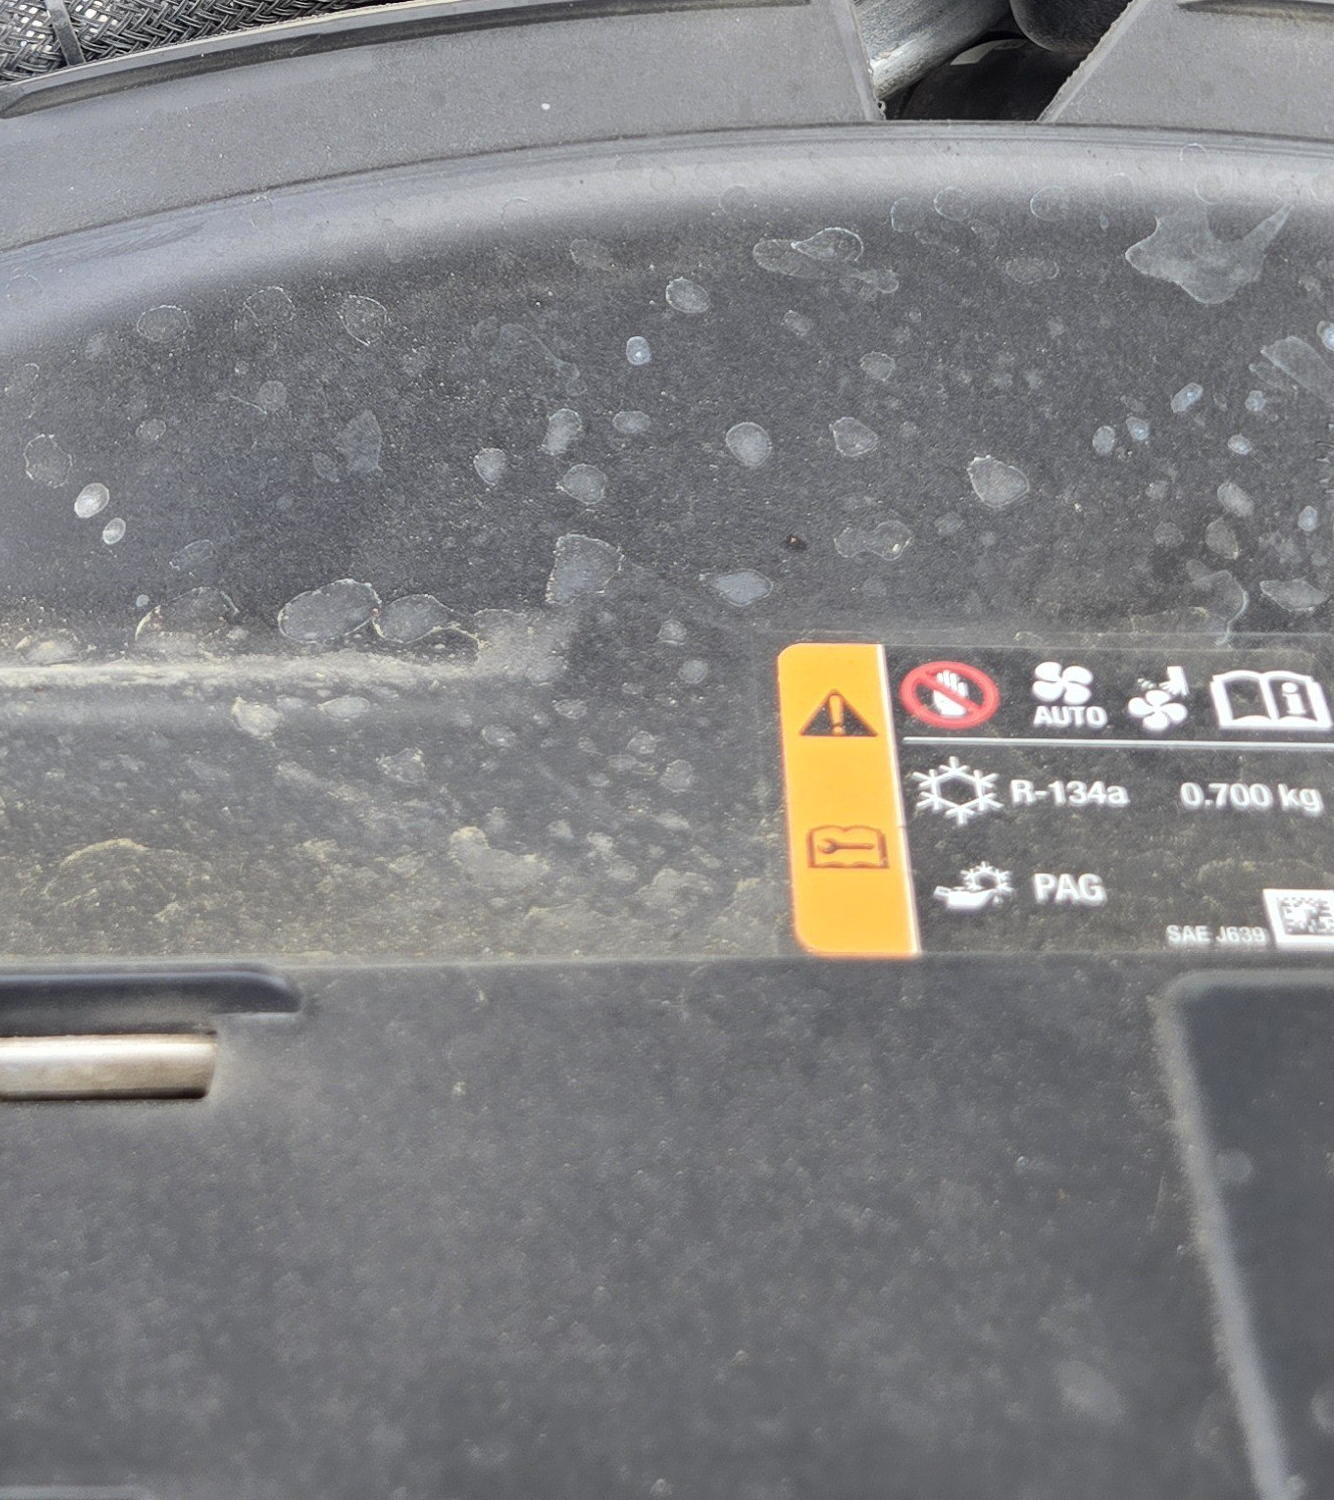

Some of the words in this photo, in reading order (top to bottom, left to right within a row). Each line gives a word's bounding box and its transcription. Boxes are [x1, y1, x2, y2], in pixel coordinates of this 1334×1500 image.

[1033, 705, 1108, 729] AUTO
[1010, 780, 1129, 806] R-134a
[1180, 782, 1271, 809] 0.700
[1278, 785, 1324, 815] kg
[1033, 874, 1105, 904] PAG
[1167, 924, 1211, 944] SAE
[1216, 926, 1267, 945] J639
